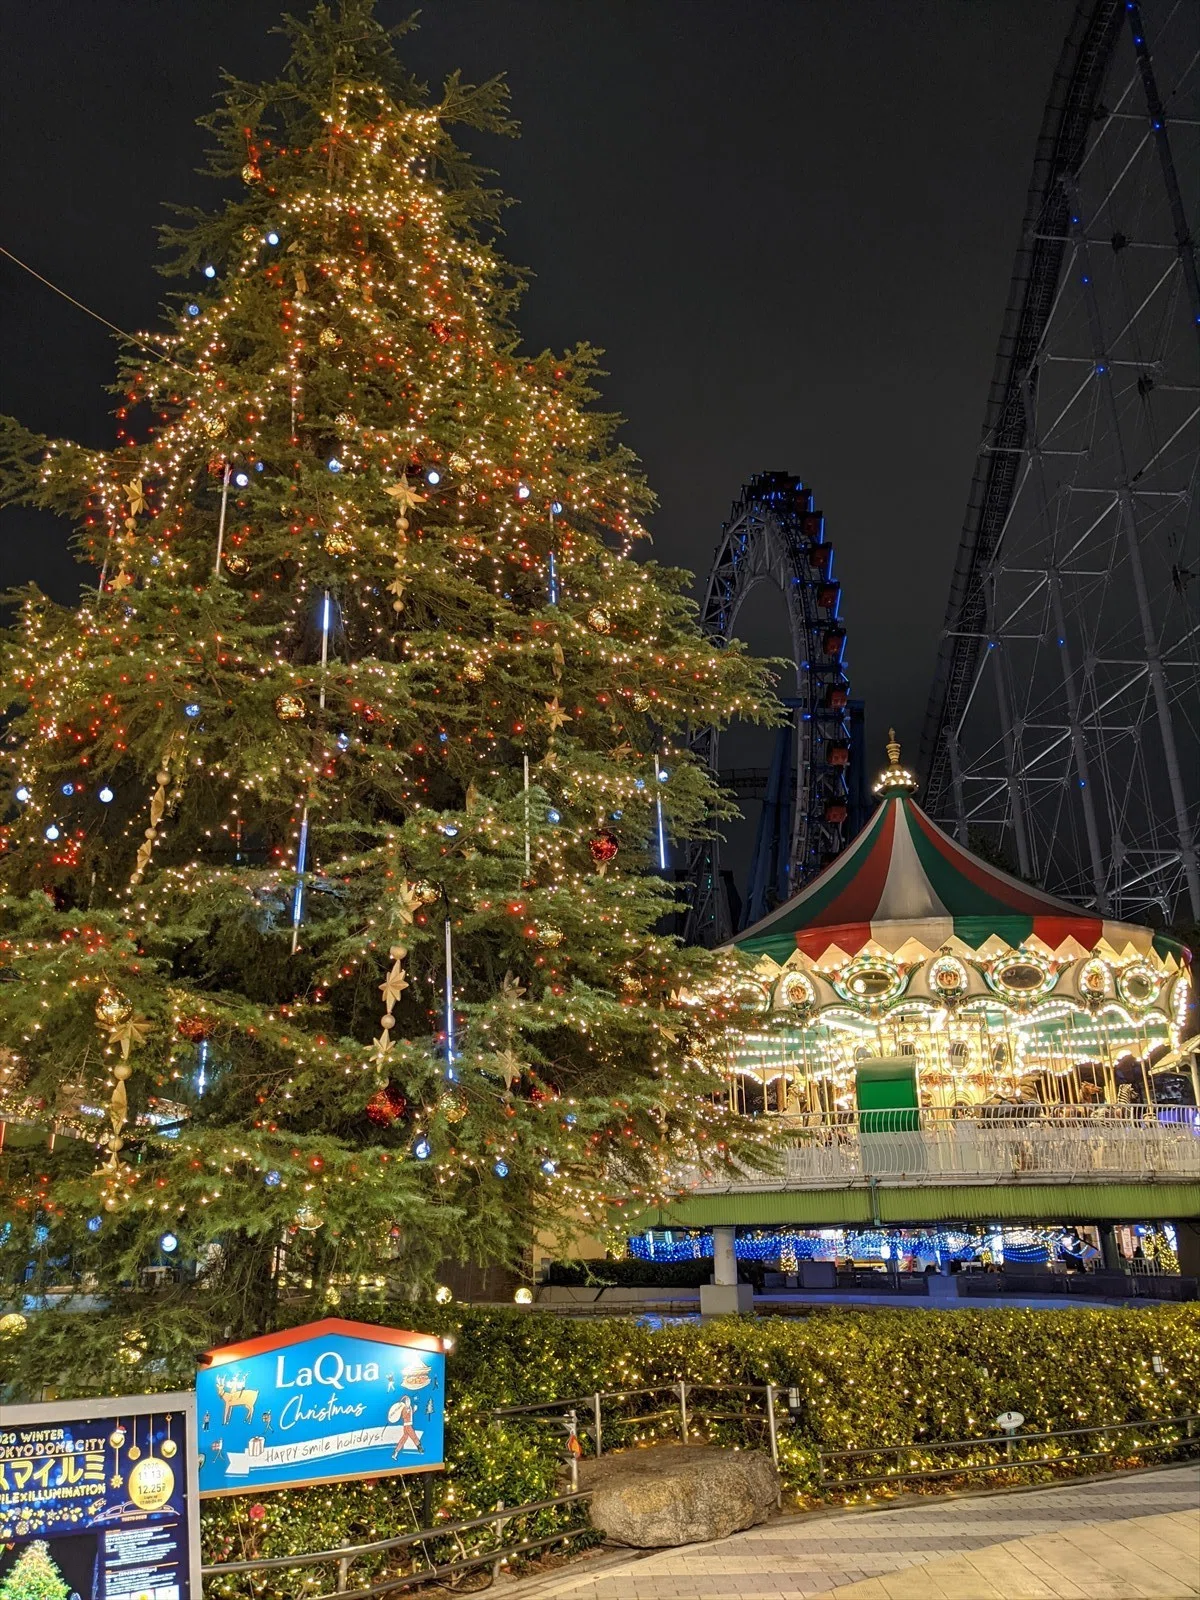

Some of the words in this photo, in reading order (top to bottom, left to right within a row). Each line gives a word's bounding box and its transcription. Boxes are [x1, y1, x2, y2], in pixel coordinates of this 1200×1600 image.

[276, 1351, 380, 1390] LaQua
[279, 1393, 367, 1430] Christmas
[0, 1432, 17, 1445] 20
[20, 1429, 65, 1443] WINTER
[36, 1440, 75, 1456] DOME
[75, 1438, 106, 1451] CITY
